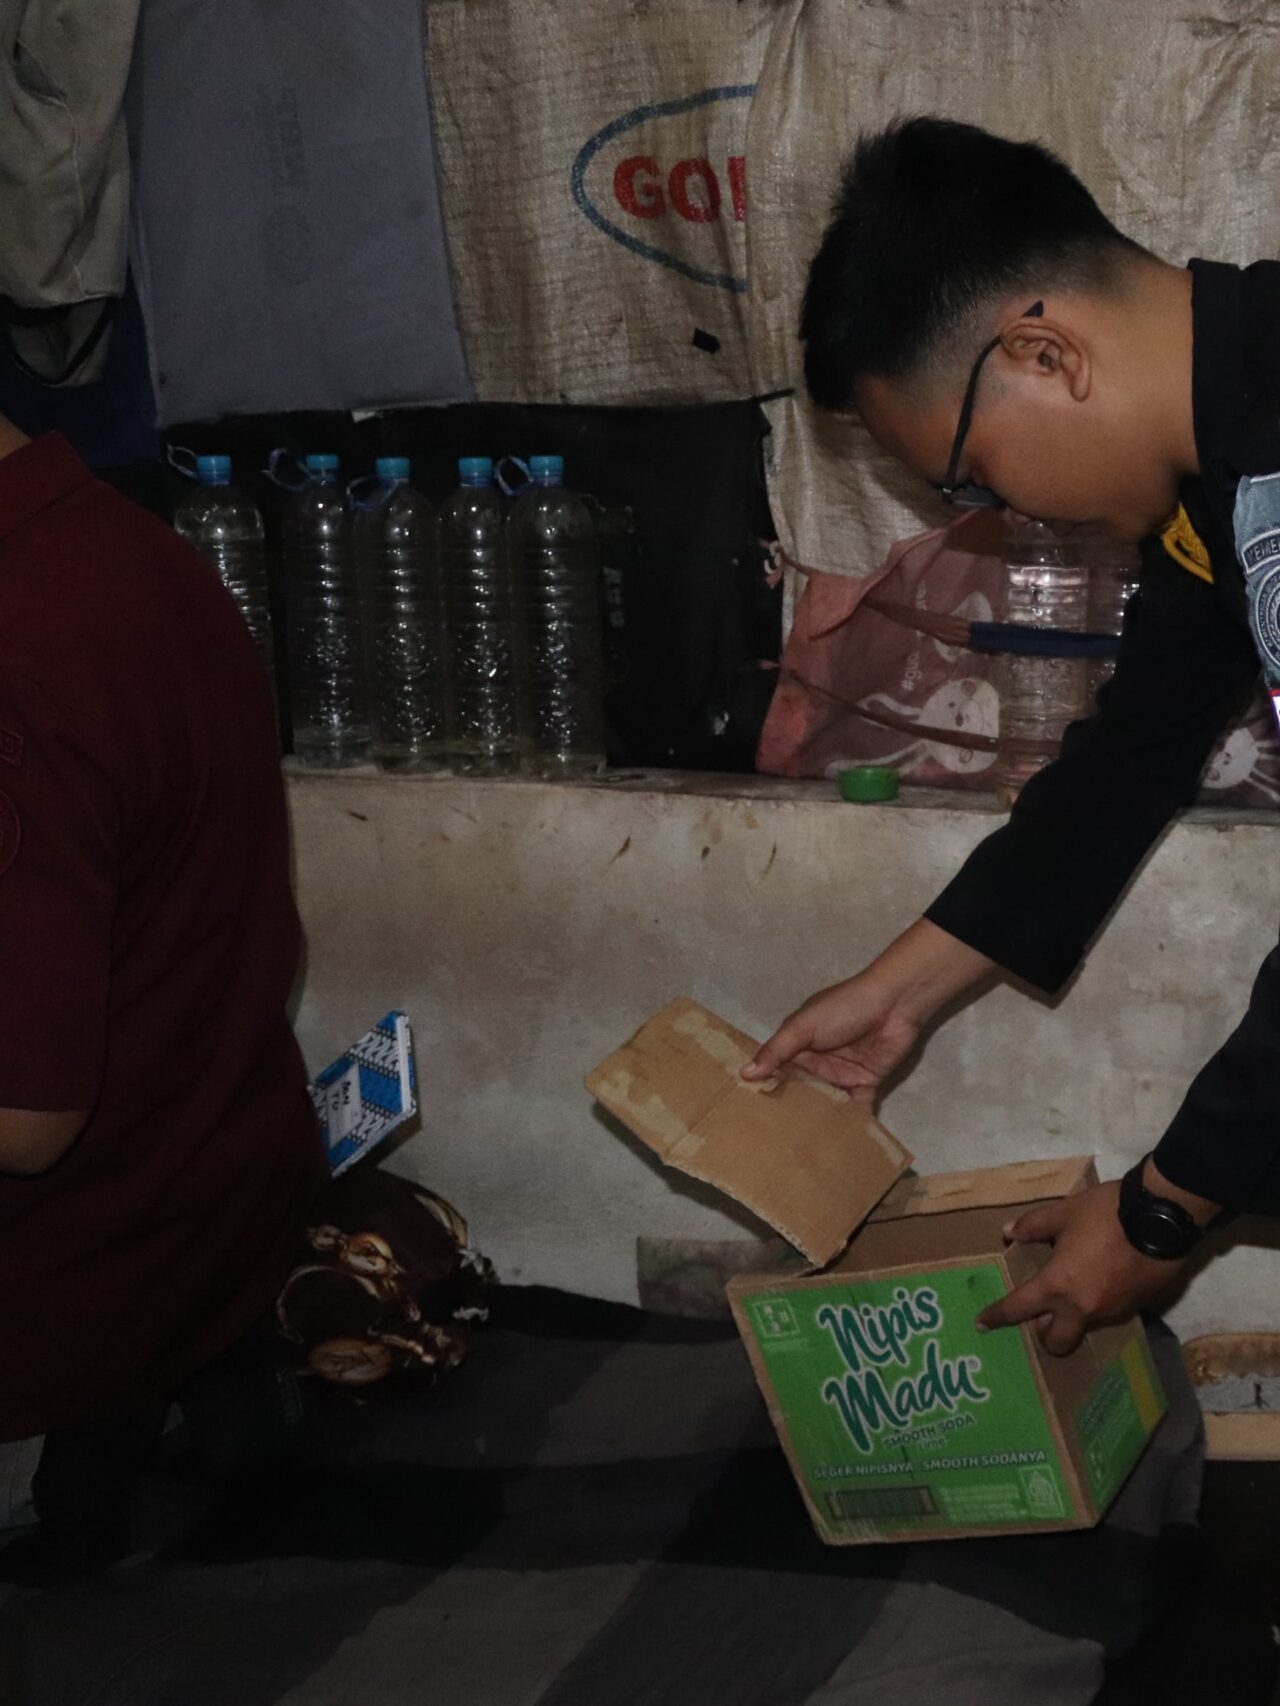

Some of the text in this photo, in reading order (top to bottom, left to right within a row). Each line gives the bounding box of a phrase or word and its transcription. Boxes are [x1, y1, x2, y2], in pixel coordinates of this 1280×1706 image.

[818, 1288, 941, 1374] Nipis
[823, 1340, 988, 1453] Madu
[884, 1414, 976, 1447] SMOOTH SODA
[814, 1450, 1046, 1480] SEGER NIPISNYA SMOOTH SODANYA
